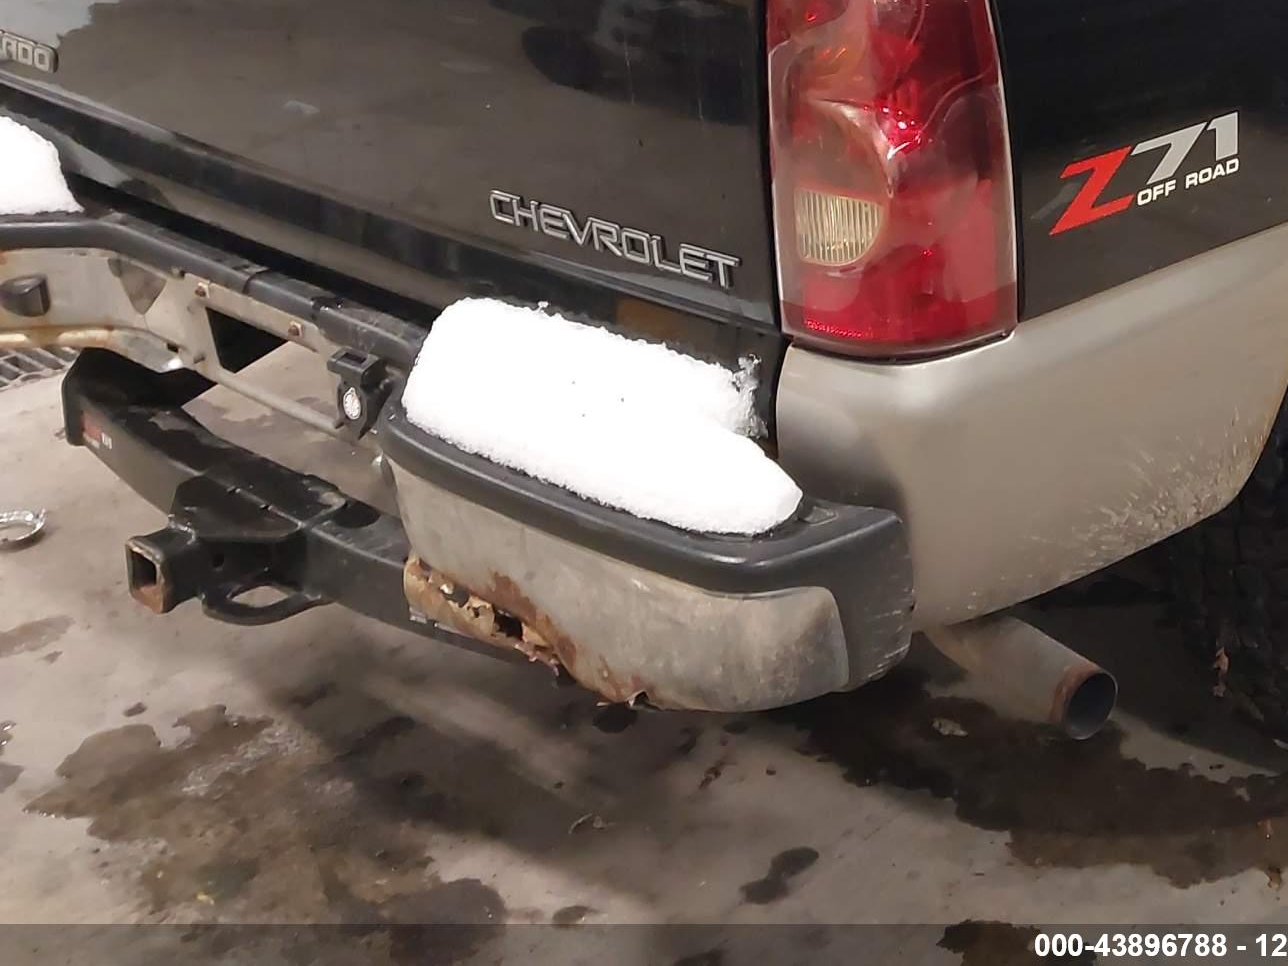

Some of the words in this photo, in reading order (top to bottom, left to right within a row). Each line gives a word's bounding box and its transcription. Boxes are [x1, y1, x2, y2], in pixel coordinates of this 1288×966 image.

[1049, 111, 1240, 236] Z71
[1136, 180, 1177, 206] OFF
[1185, 158, 1240, 190] ROAD
[489, 189, 741, 288] CHEVROLET
